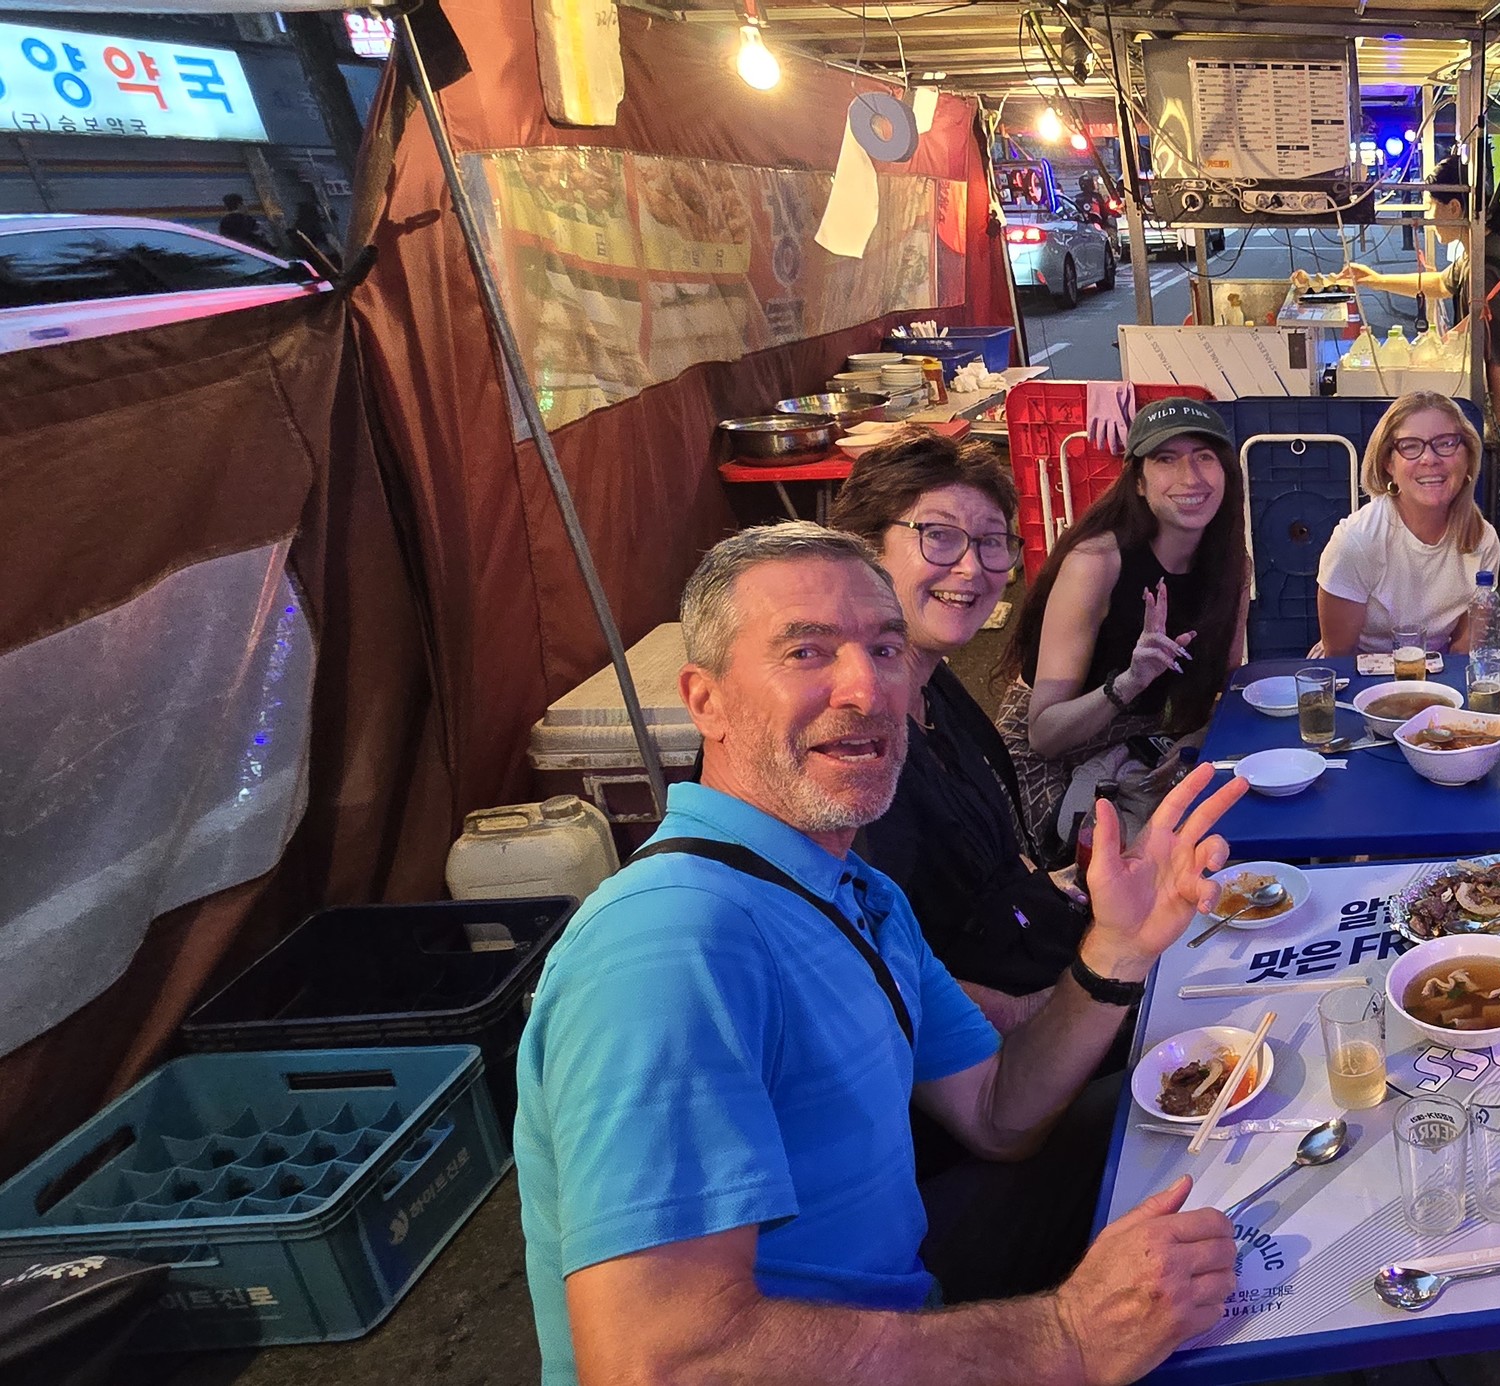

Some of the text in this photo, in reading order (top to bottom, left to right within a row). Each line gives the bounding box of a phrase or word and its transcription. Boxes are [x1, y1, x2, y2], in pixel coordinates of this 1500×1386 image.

[0, 37, 235, 114] 양약국
[1151, 341, 1172, 371] STAINLESS
[1203, 341, 1224, 371] STAINLESS
[1256, 338, 1277, 371] STAINLESS
[1147, 407, 1176, 422] WILD
[1246, 939, 1342, 983] 맛은
[1348, 929, 1416, 966] FR
[1238, 1288, 1260, 1304] 맛은
[1263, 1285, 1294, 1299] 그대로
